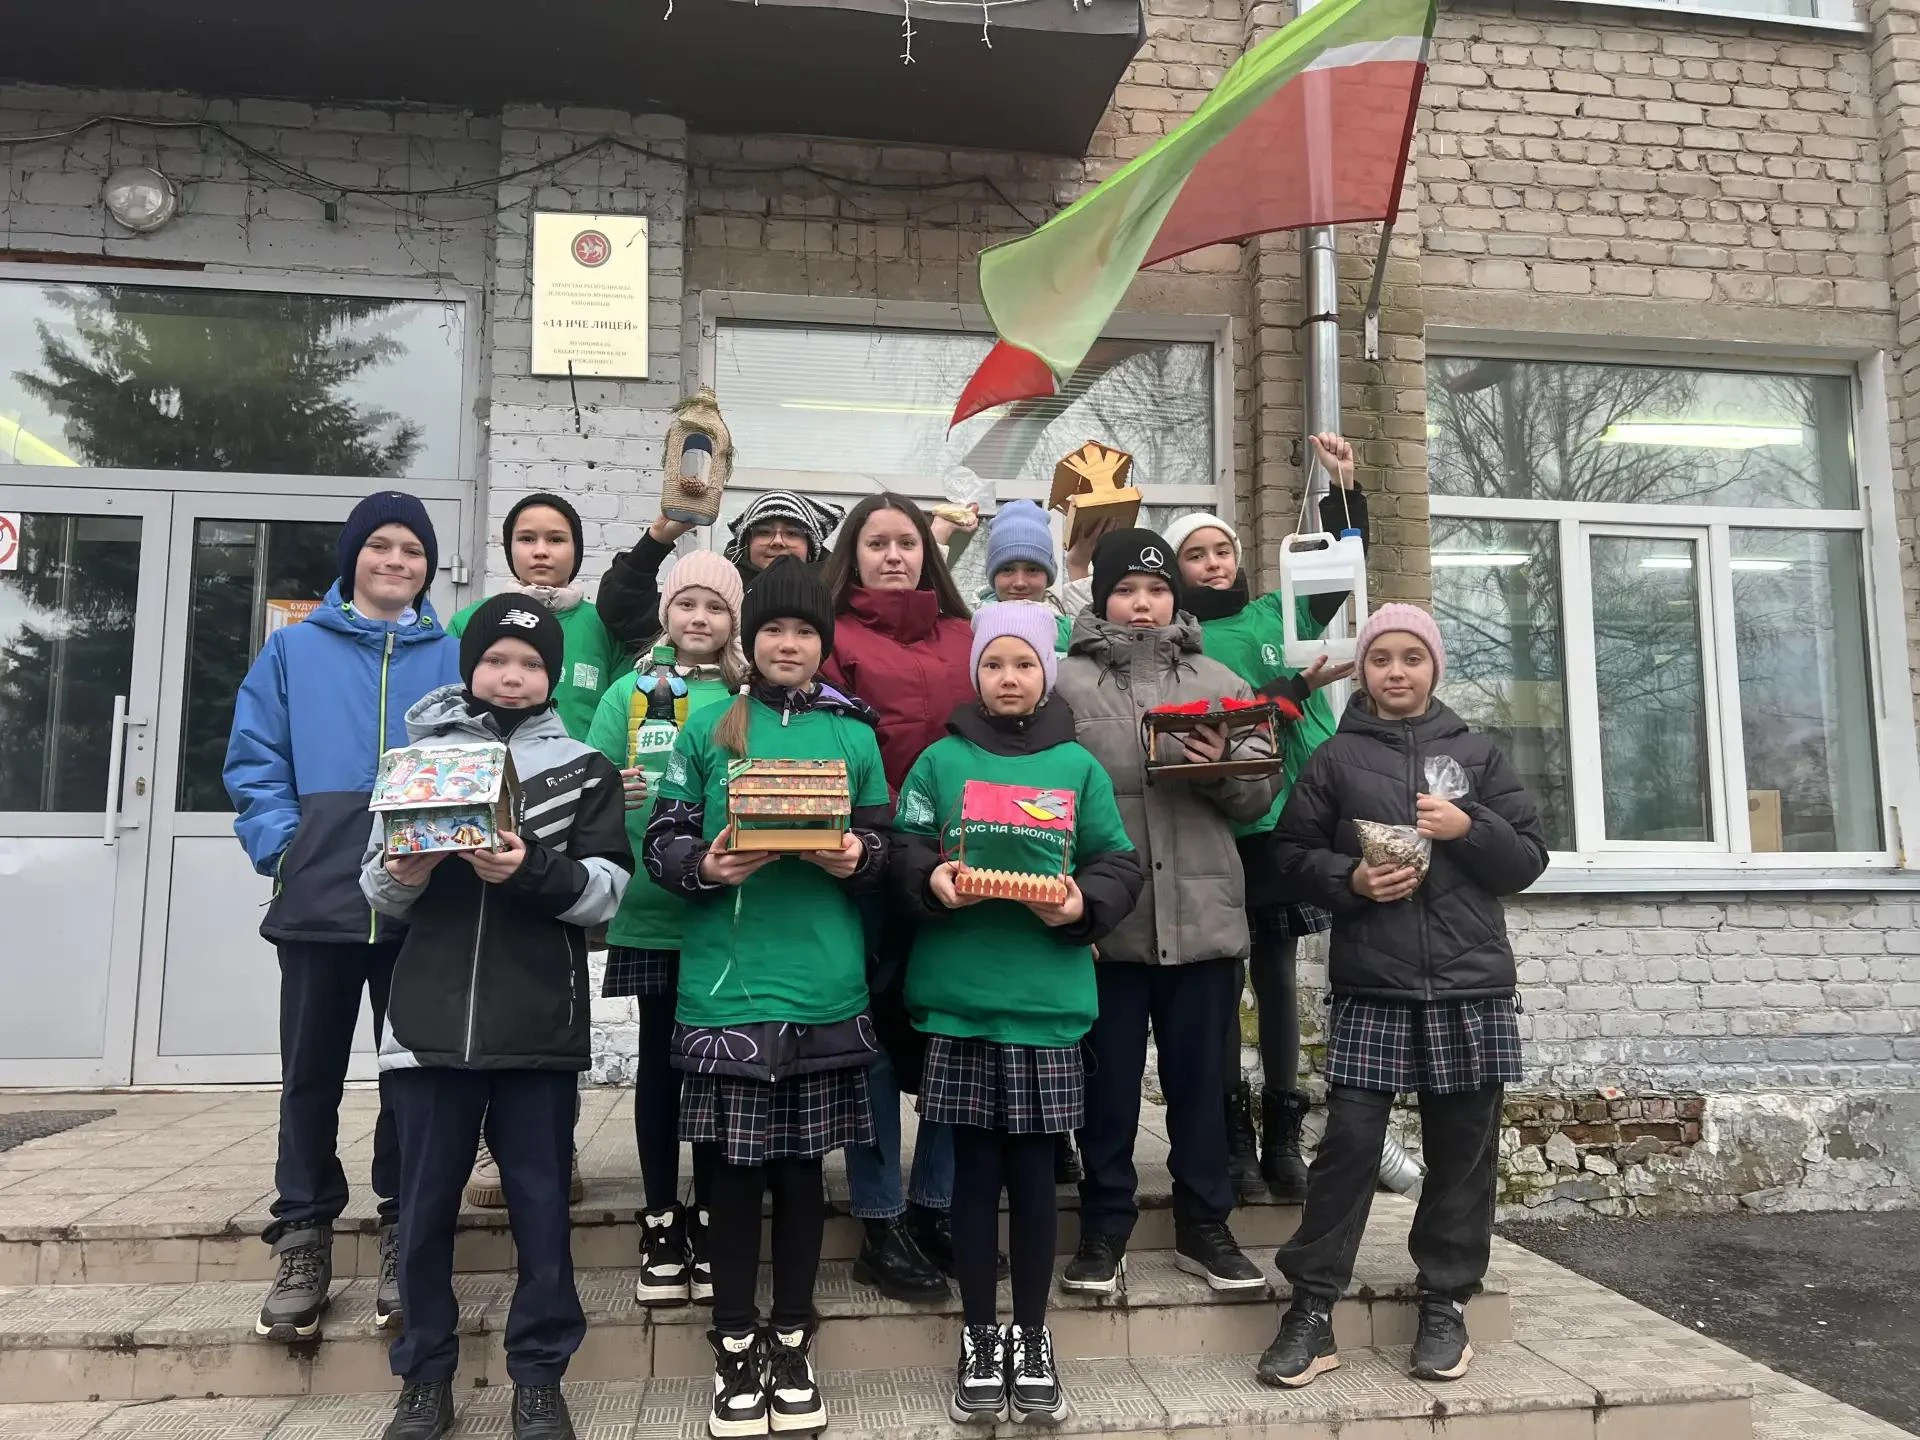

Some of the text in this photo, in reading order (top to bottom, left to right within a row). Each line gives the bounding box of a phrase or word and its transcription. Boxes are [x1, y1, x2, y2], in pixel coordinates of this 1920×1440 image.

[566, 319, 589, 329] НЧЕ
[590, 320, 638, 331] ЛИЦЕЙ»
[990, 824, 1008, 834] НА
